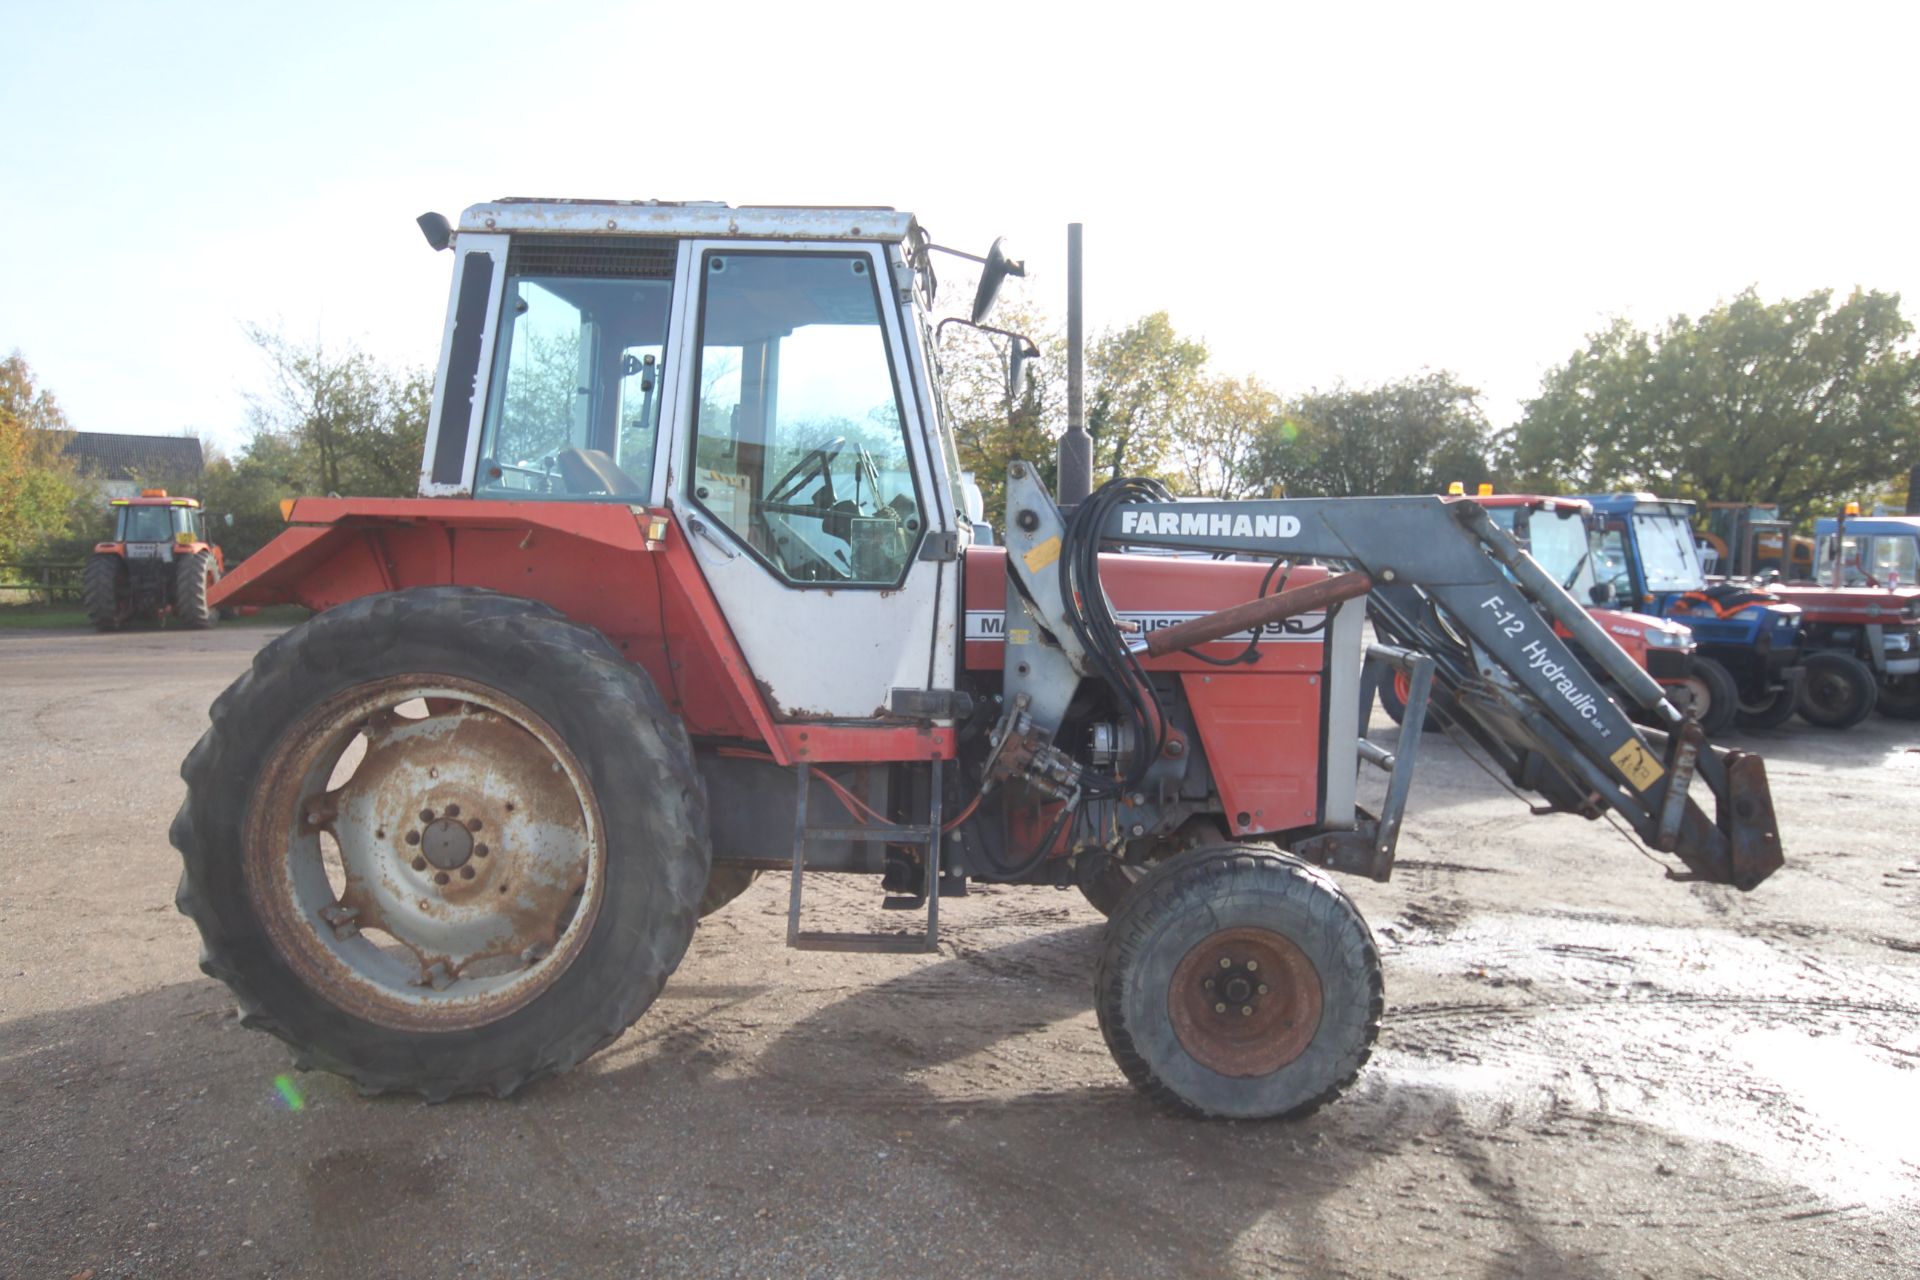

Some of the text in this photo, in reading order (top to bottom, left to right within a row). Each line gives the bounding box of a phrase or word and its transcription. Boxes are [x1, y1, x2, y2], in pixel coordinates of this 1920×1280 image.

[1121, 511, 1301, 538] FARMHAND
[1481, 595, 1525, 638] F-12
[1521, 639, 1598, 720] Hydraulic
